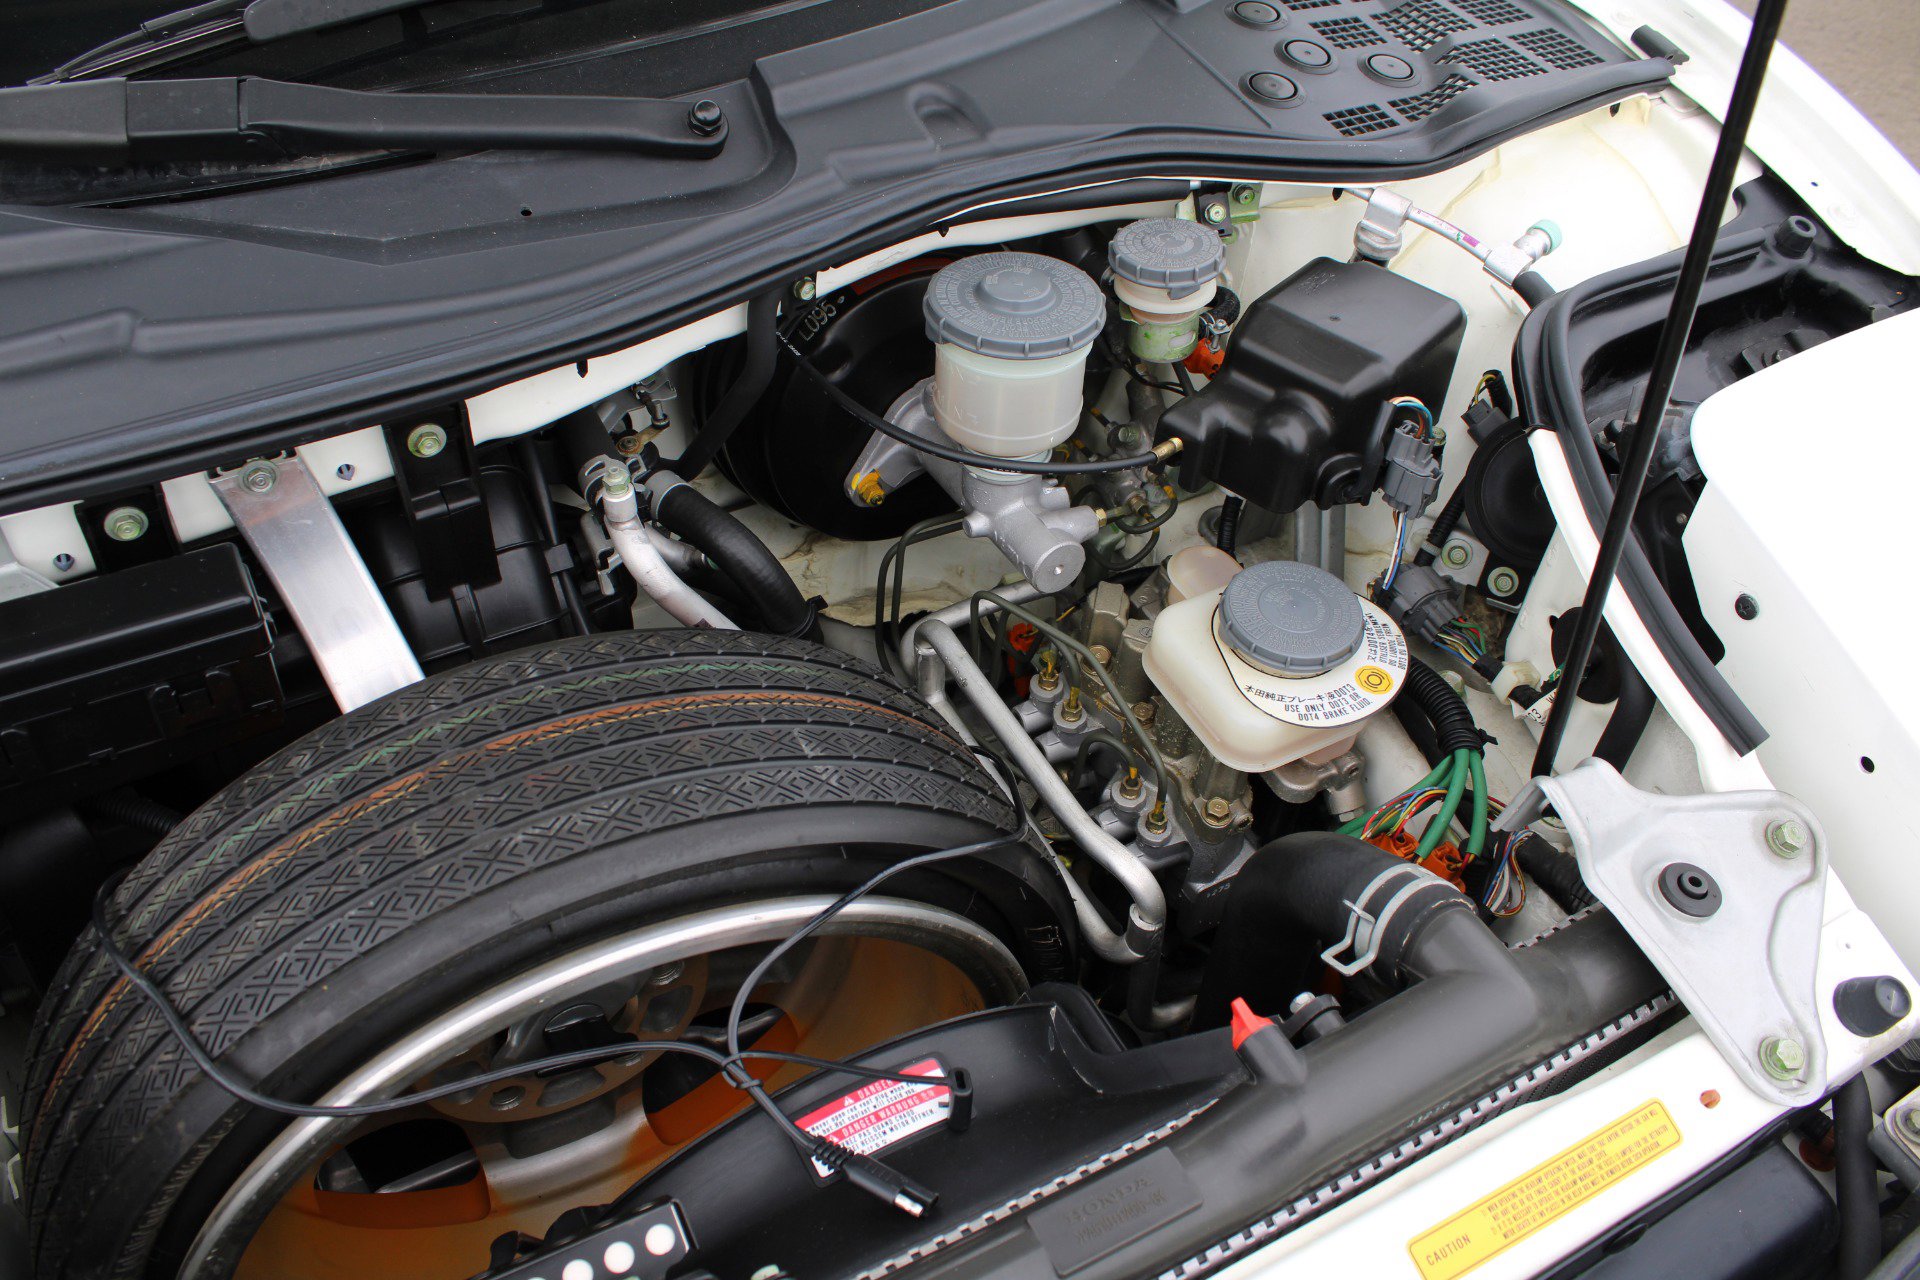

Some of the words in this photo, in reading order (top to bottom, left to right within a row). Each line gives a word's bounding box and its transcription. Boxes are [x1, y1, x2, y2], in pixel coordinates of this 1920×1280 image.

[1284, 703, 1299, 712] USE
[1304, 702, 1324, 712] ONLY
[1329, 697, 1349, 708] DOT3
[1350, 691, 1362, 701] OR
[1297, 712, 1320, 722] DOT4
[1323, 706, 1349, 719] BRAKE
[842, 1114, 877, 1138] DANGER
[878, 1096, 920, 1119] WARNUNG
[1426, 1233, 1472, 1267] CAUTION
